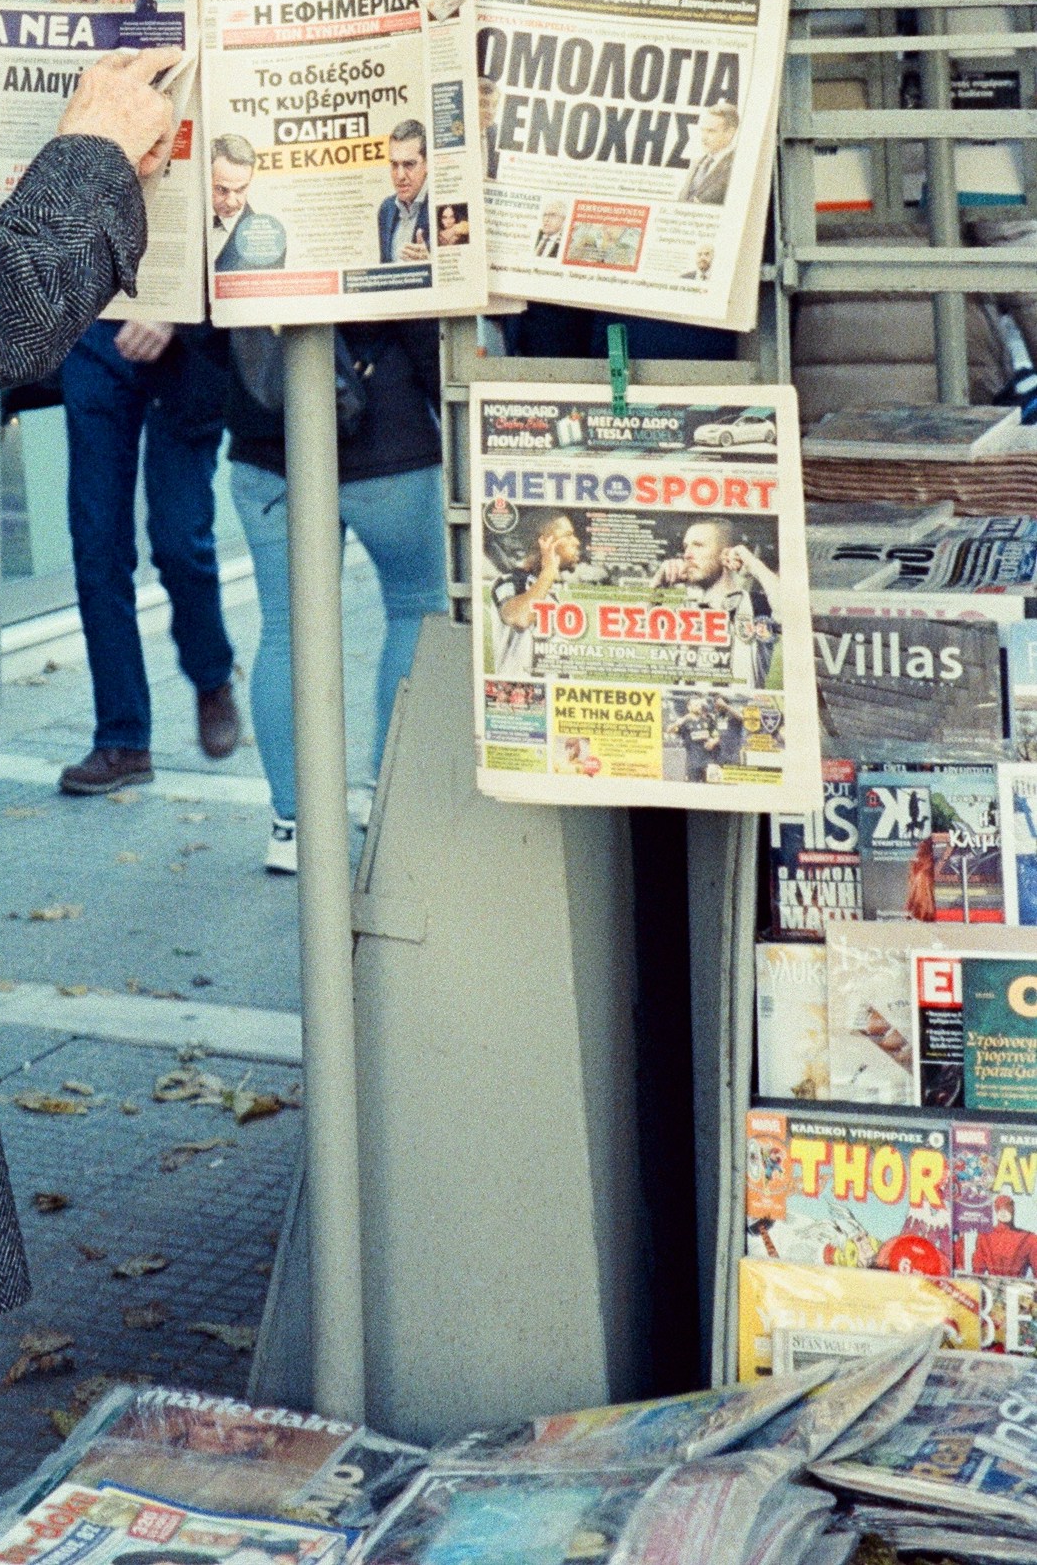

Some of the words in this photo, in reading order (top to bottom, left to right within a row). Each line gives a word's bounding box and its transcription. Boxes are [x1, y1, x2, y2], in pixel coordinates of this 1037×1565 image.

[253, 5, 272, 26] Η
[19, 13, 95, 48] ΝΕΑ
[255, 68, 282, 87] Το
[289, 59, 385, 86] αδιέξοδο
[477, 26, 741, 108] ΟΜΟΛΟΓΙΑ
[229, 96, 270, 116] της
[276, 85, 408, 114] κυβέρνησης
[278, 117, 366, 143] ΟΔΗΓΕΙ
[498, 94, 700, 170] ΕΝΟΧΗΣ
[256, 151, 283, 172] ΣΕ
[290, 141, 386, 170] ΕΚΛΟΓΕΣ
[484, 404, 559, 418] NOVIBOARD
[587, 416, 640, 428] ΜΕΓΑΛΟ
[641, 418, 680, 430] ΔΩΡΟ
[487, 432, 552, 448] novibet
[596, 427, 633, 440] TESLA
[532, 601, 586, 636] ΤΟ
[598, 605, 730, 644] ΕΣΩΣΕ
[534, 642, 603, 656] ΝΙΚΩΝΤΑΣ
[650, 647, 696, 662] ΕΑΥΤΟ
[700, 650, 731, 664] ΤΟΥ
[816, 631, 964, 681] Villas
[555, 687, 656, 707] ΡΑΝΤΕΒΟΥ
[554, 706, 577, 719] ΜΕ
[580, 707, 611, 721] ΤΗΝ
[614, 709, 655, 723] 6ΑΔΑ
[791, 1123, 846, 1137] ΚΛΑΣΙΚΟΙ
[850, 1128, 923, 1144] ΥΠΕΡΗΡΩΕΣ
[789, 1137, 950, 1209] THOR
[137, 1386, 252, 1419] marie
[253, 1406, 354, 1436] claire
